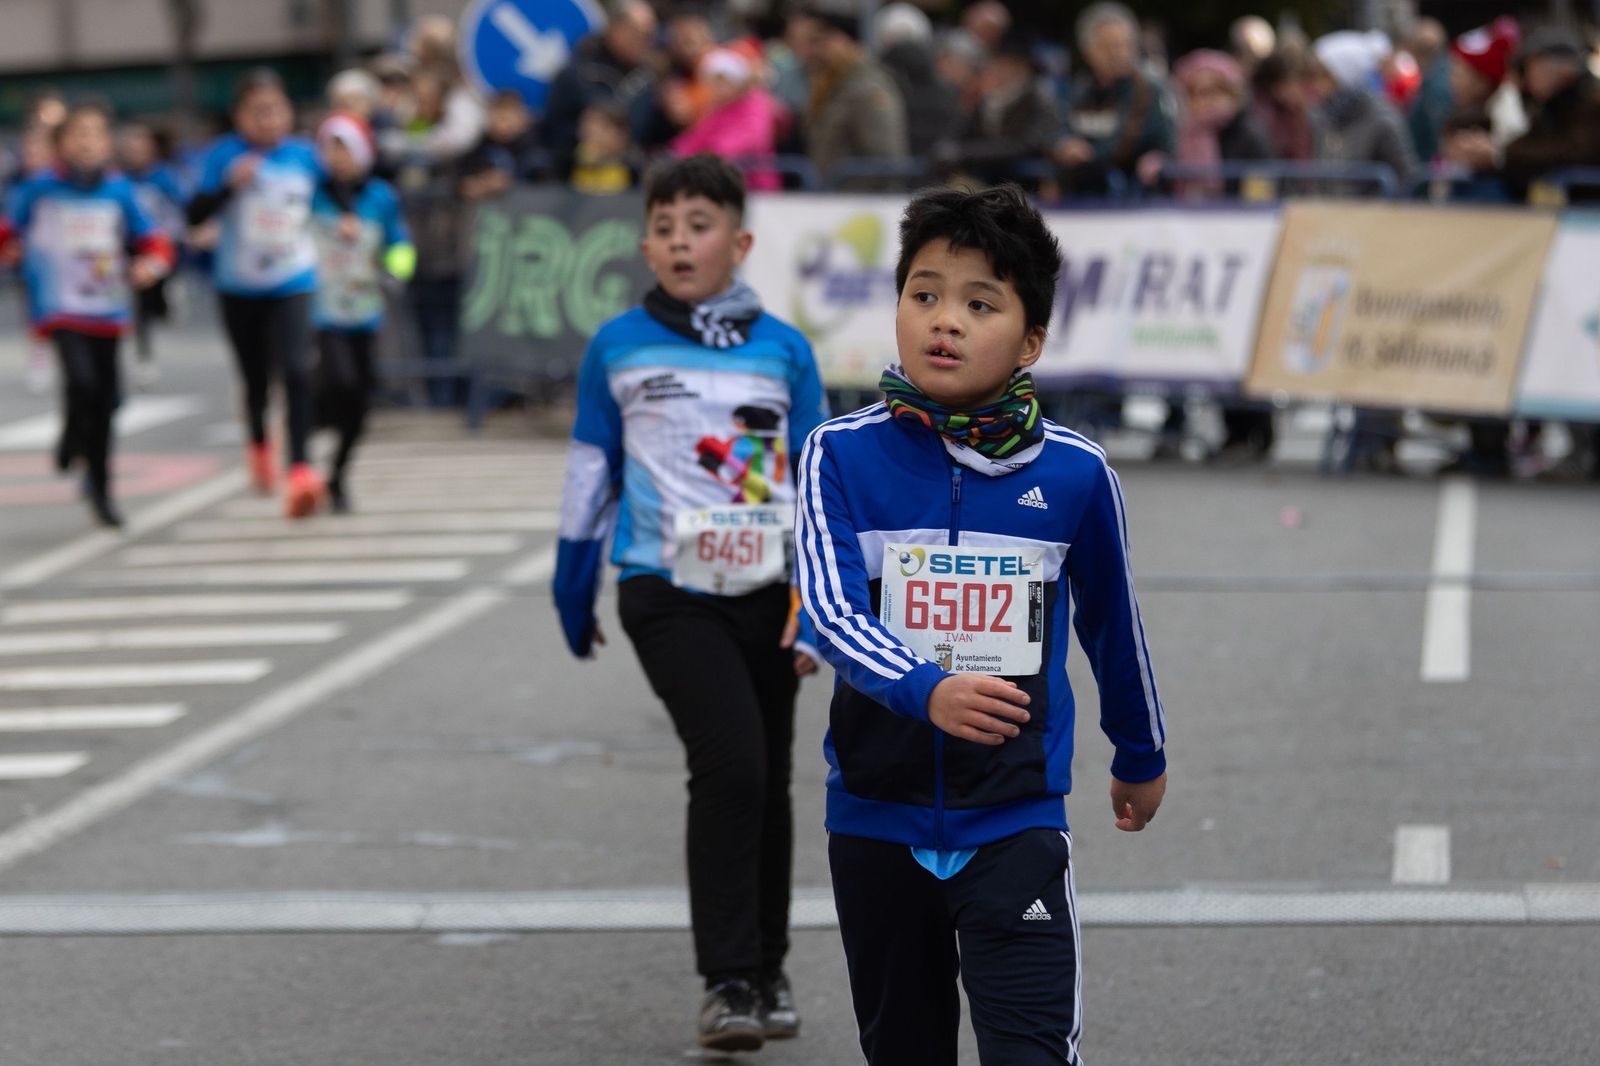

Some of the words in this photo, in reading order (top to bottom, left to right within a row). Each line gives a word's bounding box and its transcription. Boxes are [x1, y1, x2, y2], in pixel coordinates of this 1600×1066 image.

[1017, 498, 1048, 510] adidas
[711, 511, 784, 526] SETEL
[697, 529, 765, 567] 6451
[929, 553, 1031, 576] SETEL
[905, 580, 1013, 633] 6502
[944, 632, 973, 643] IVAN
[955, 653, 1002, 663] Ayuntamiento
[955, 663, 964, 671] de
[965, 664, 1002, 672] Salamanca
[1022, 912, 1052, 921] adidas
